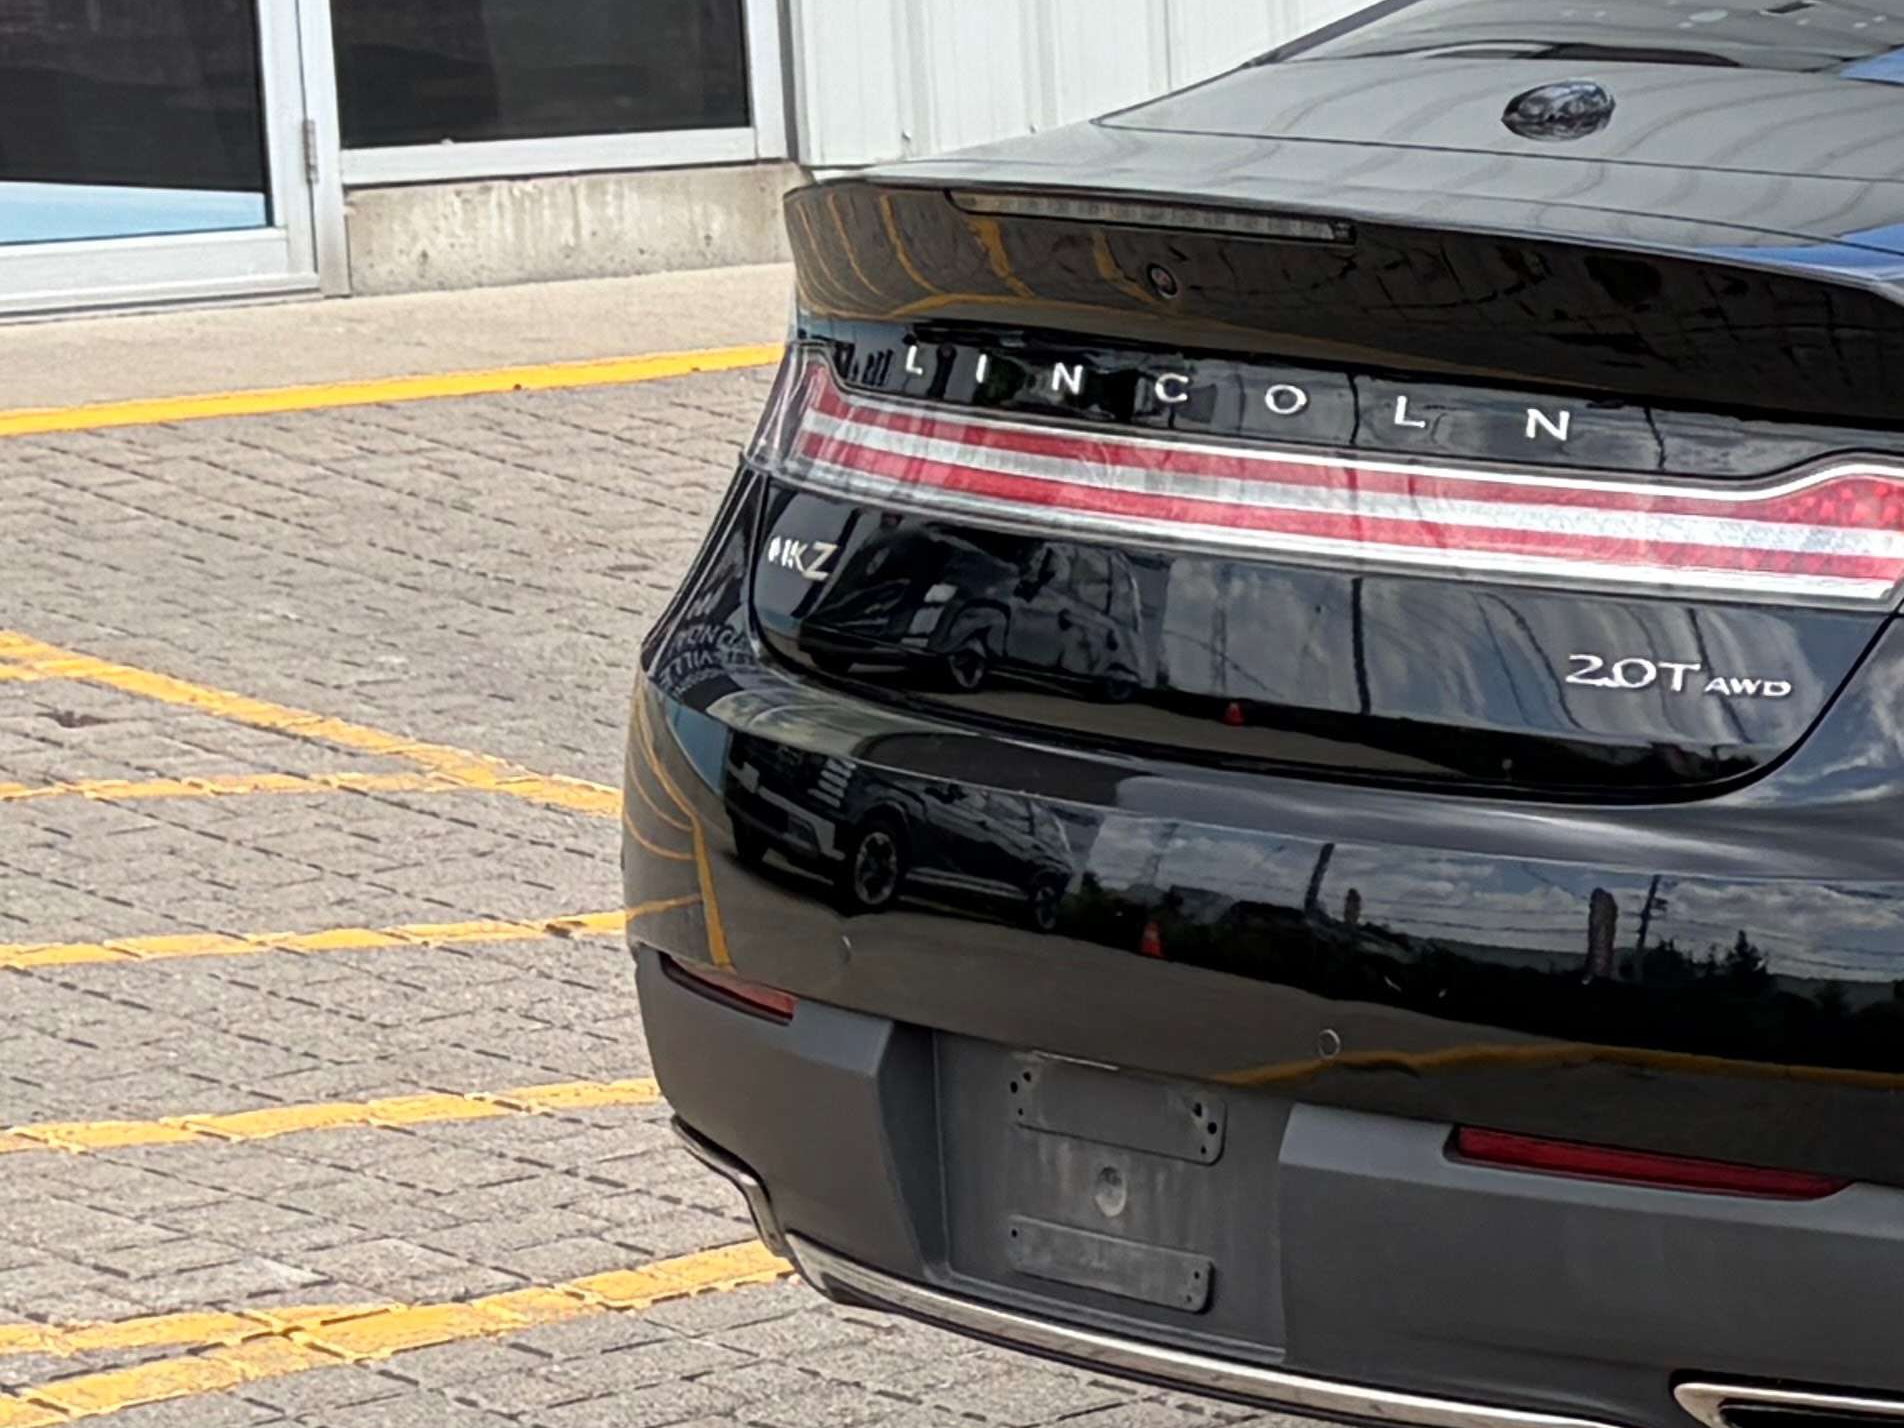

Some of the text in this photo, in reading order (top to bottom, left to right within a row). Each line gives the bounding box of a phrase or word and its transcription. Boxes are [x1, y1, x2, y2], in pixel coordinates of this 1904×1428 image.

[905, 344, 1572, 442] LINCOLN
[768, 535, 838, 581] MKZ
[1703, 676, 1792, 696] AWD
